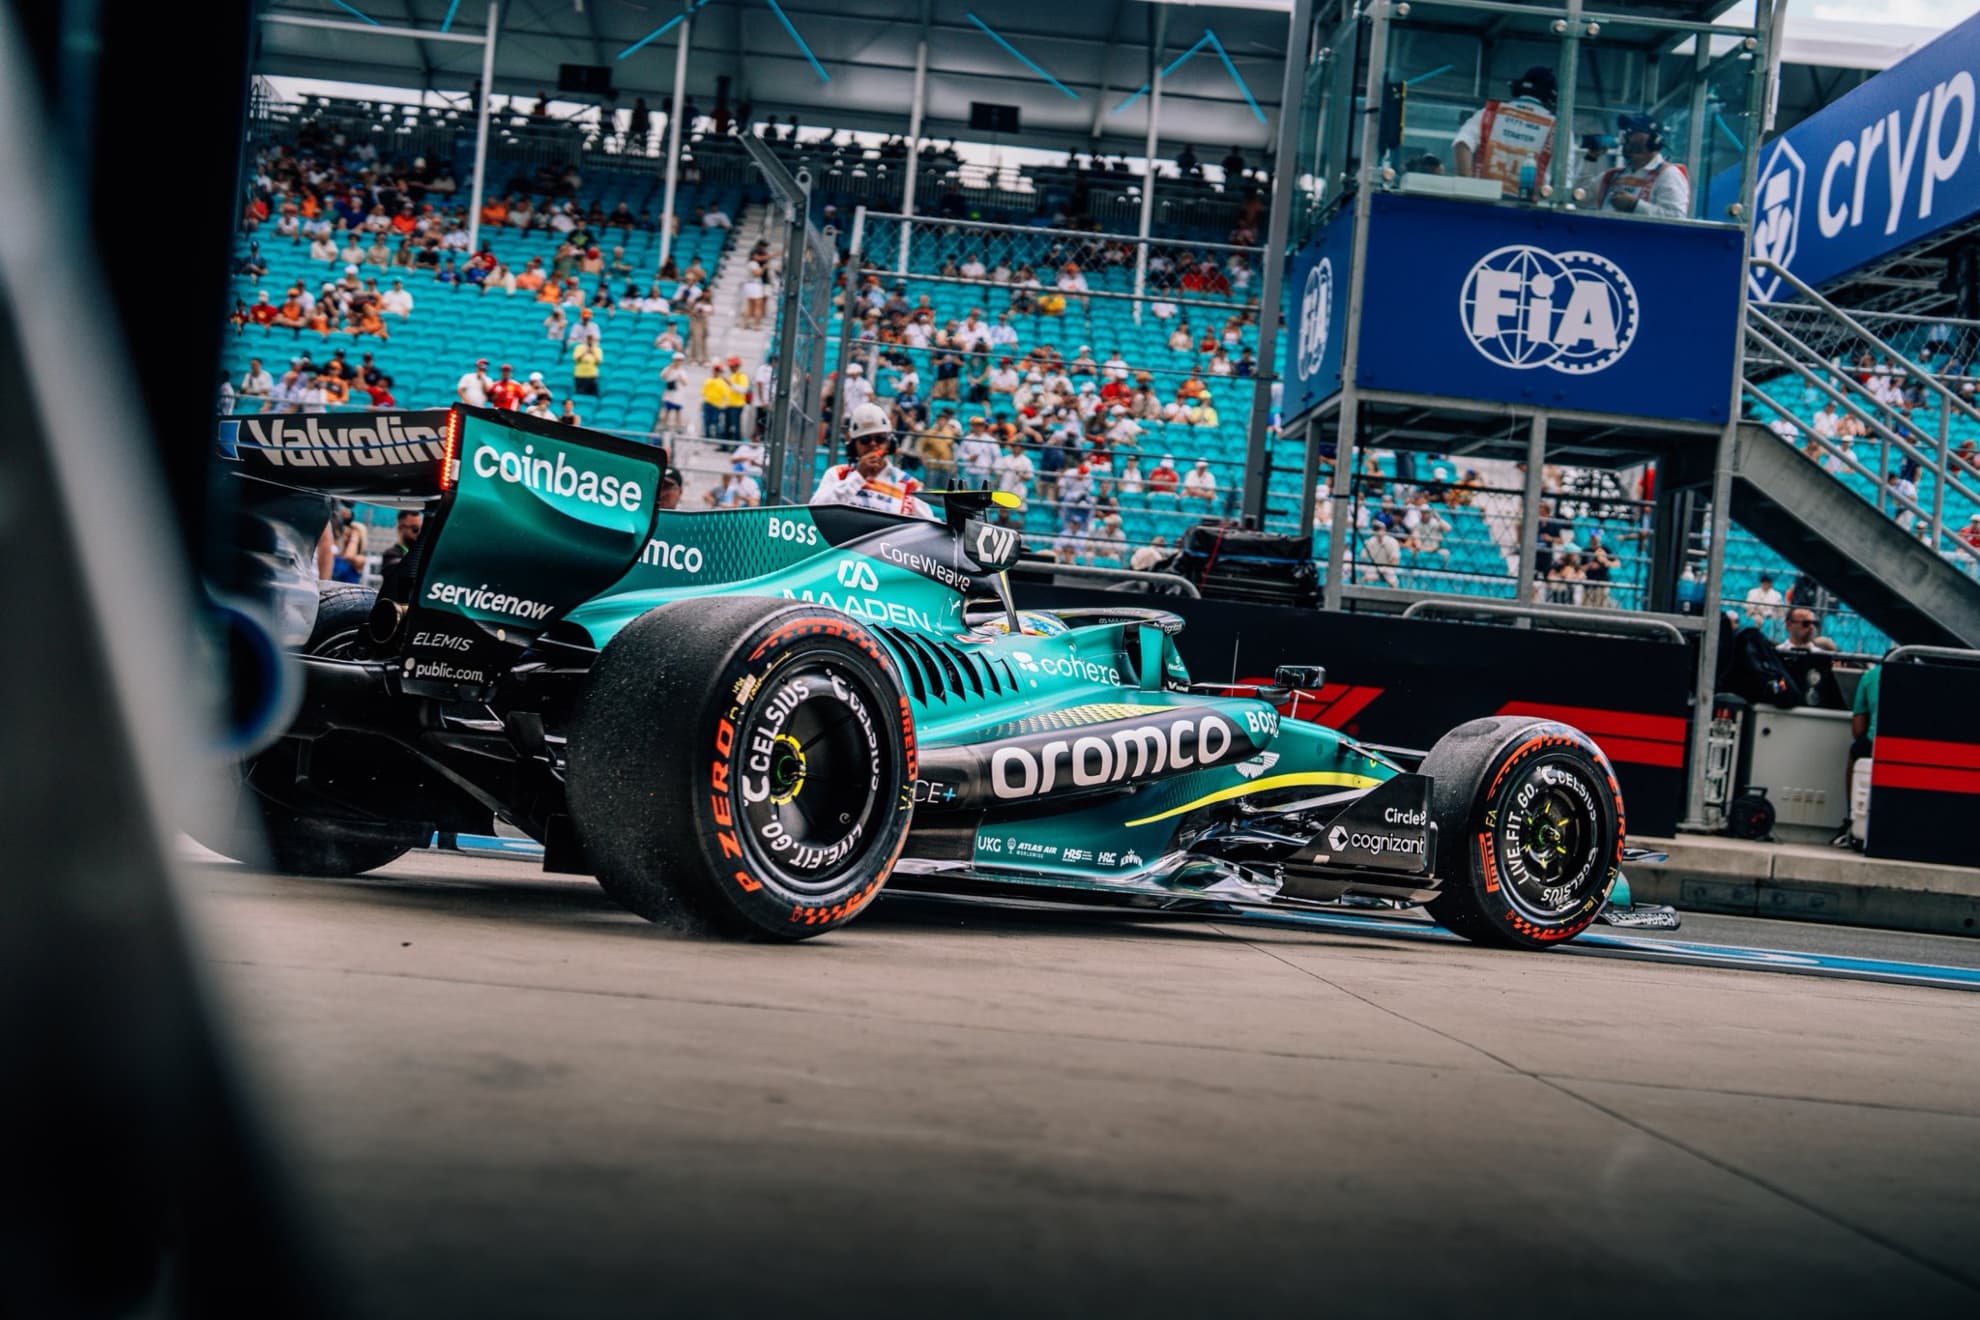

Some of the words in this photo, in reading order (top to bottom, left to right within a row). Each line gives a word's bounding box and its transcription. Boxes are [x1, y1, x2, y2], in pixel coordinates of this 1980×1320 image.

[473, 444, 642, 511] coinbase
[768, 517, 818, 545] BOSS
[879, 541, 970, 592] CoreWeave
[427, 580, 554, 621] servicenow
[412, 632, 474, 652] ELEMIS
[415, 661, 483, 682] public.com
[1041, 653, 1121, 688] cohere
[750, 680, 810, 772] CELSIUS
[991, 715, 1232, 800] aramco
[711, 718, 743, 860] ZERO
[977, 836, 1002, 853] UKG
[1018, 842, 1043, 852] ATLAS
[1044, 845, 1057, 854] AIR
[1351, 832, 1424, 855] cognizant
